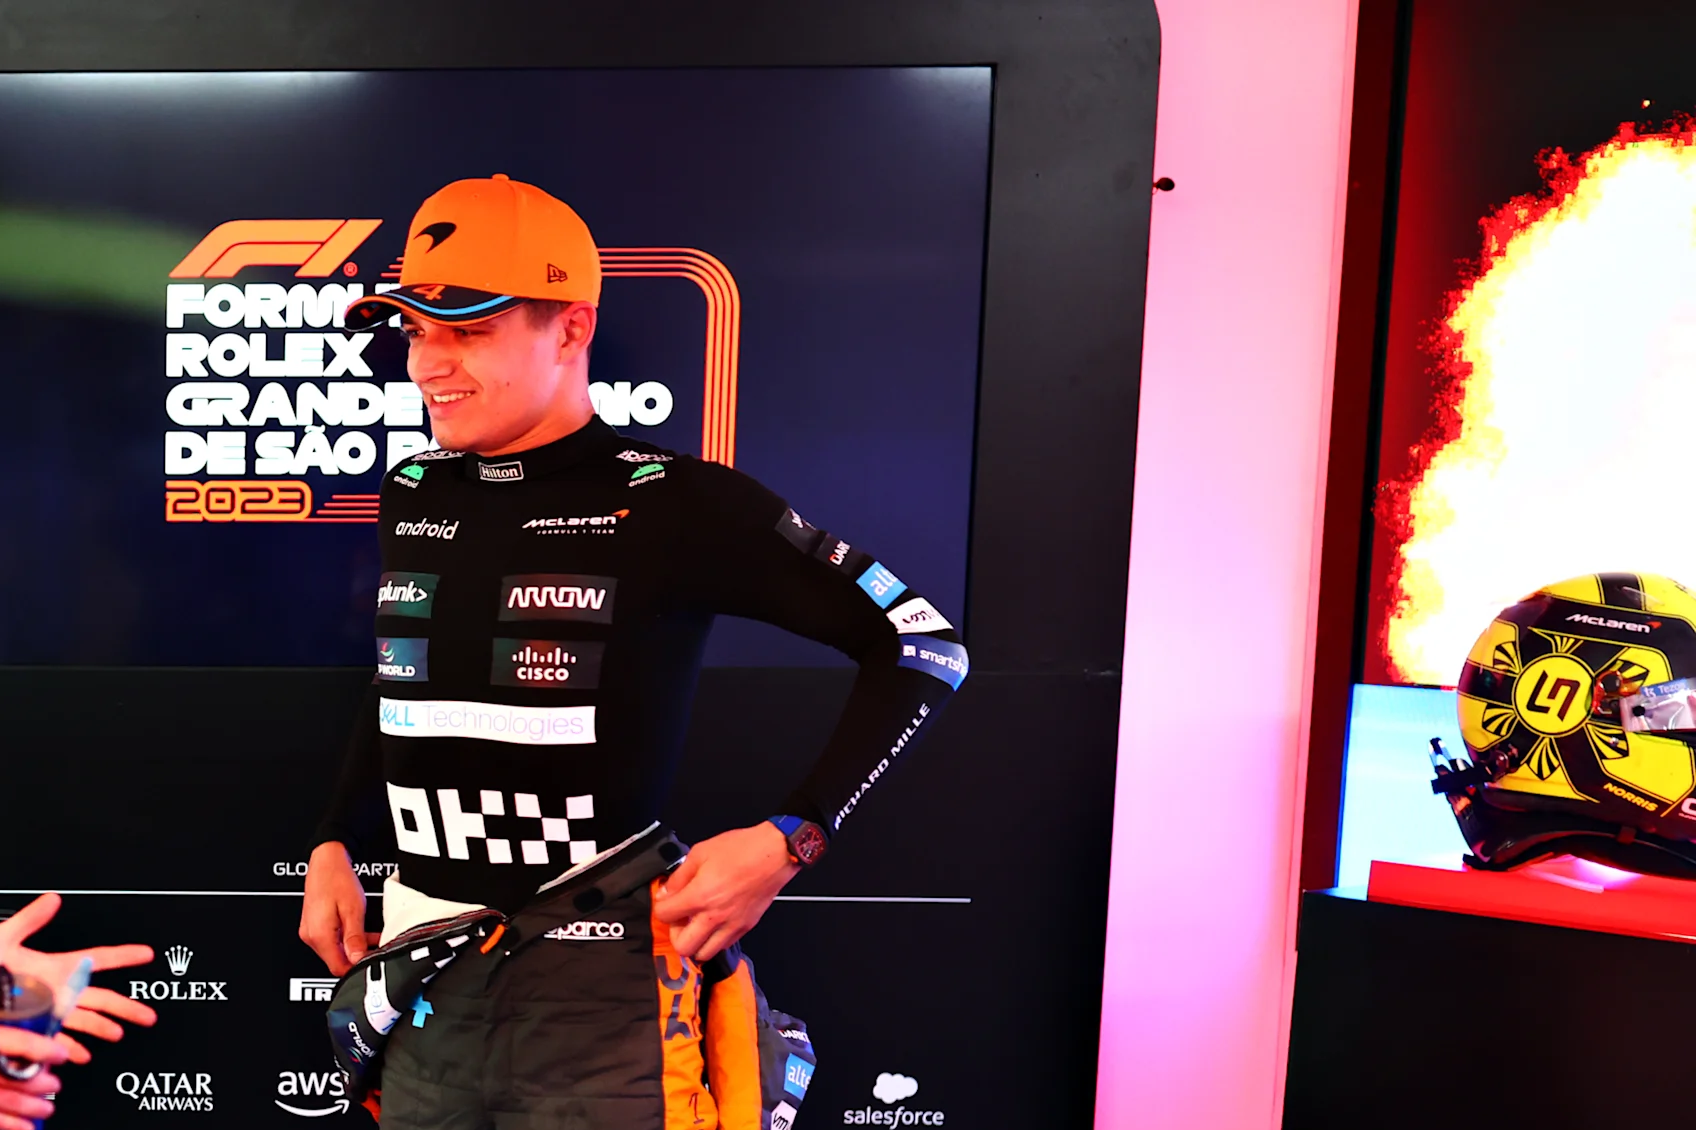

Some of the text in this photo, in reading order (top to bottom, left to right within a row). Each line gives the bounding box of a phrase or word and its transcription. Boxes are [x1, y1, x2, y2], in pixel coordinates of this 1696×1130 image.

[166, 333, 374, 377] ROLEX
[166, 382, 423, 426] GRANDE
[165, 431, 246, 475] DE
[255, 425, 377, 475] SÃO
[393, 475, 419, 489] android
[481, 466, 519, 479] Hilton
[628, 471, 666, 487] android
[166, 480, 313, 523] 2023
[395, 518, 460, 540] android
[522, 515, 617, 529] McLaren
[507, 586, 606, 610] ARROW
[1565, 613, 1651, 633] McLaren
[517, 667, 570, 681] CISCO
[423, 705, 585, 741] Technologies
[834, 702, 931, 831] RICHARD MILLE
[1603, 782, 1659, 812] NORRIS
[386, 781, 598, 865] OKX
[543, 921, 625, 940] parco
[129, 981, 228, 1001] ROLEX
[115, 1071, 214, 1099] QATAR
[277, 1071, 346, 1096] aws
[138, 1097, 214, 1111] AIRWAYS
[843, 1106, 945, 1130] salesforce
